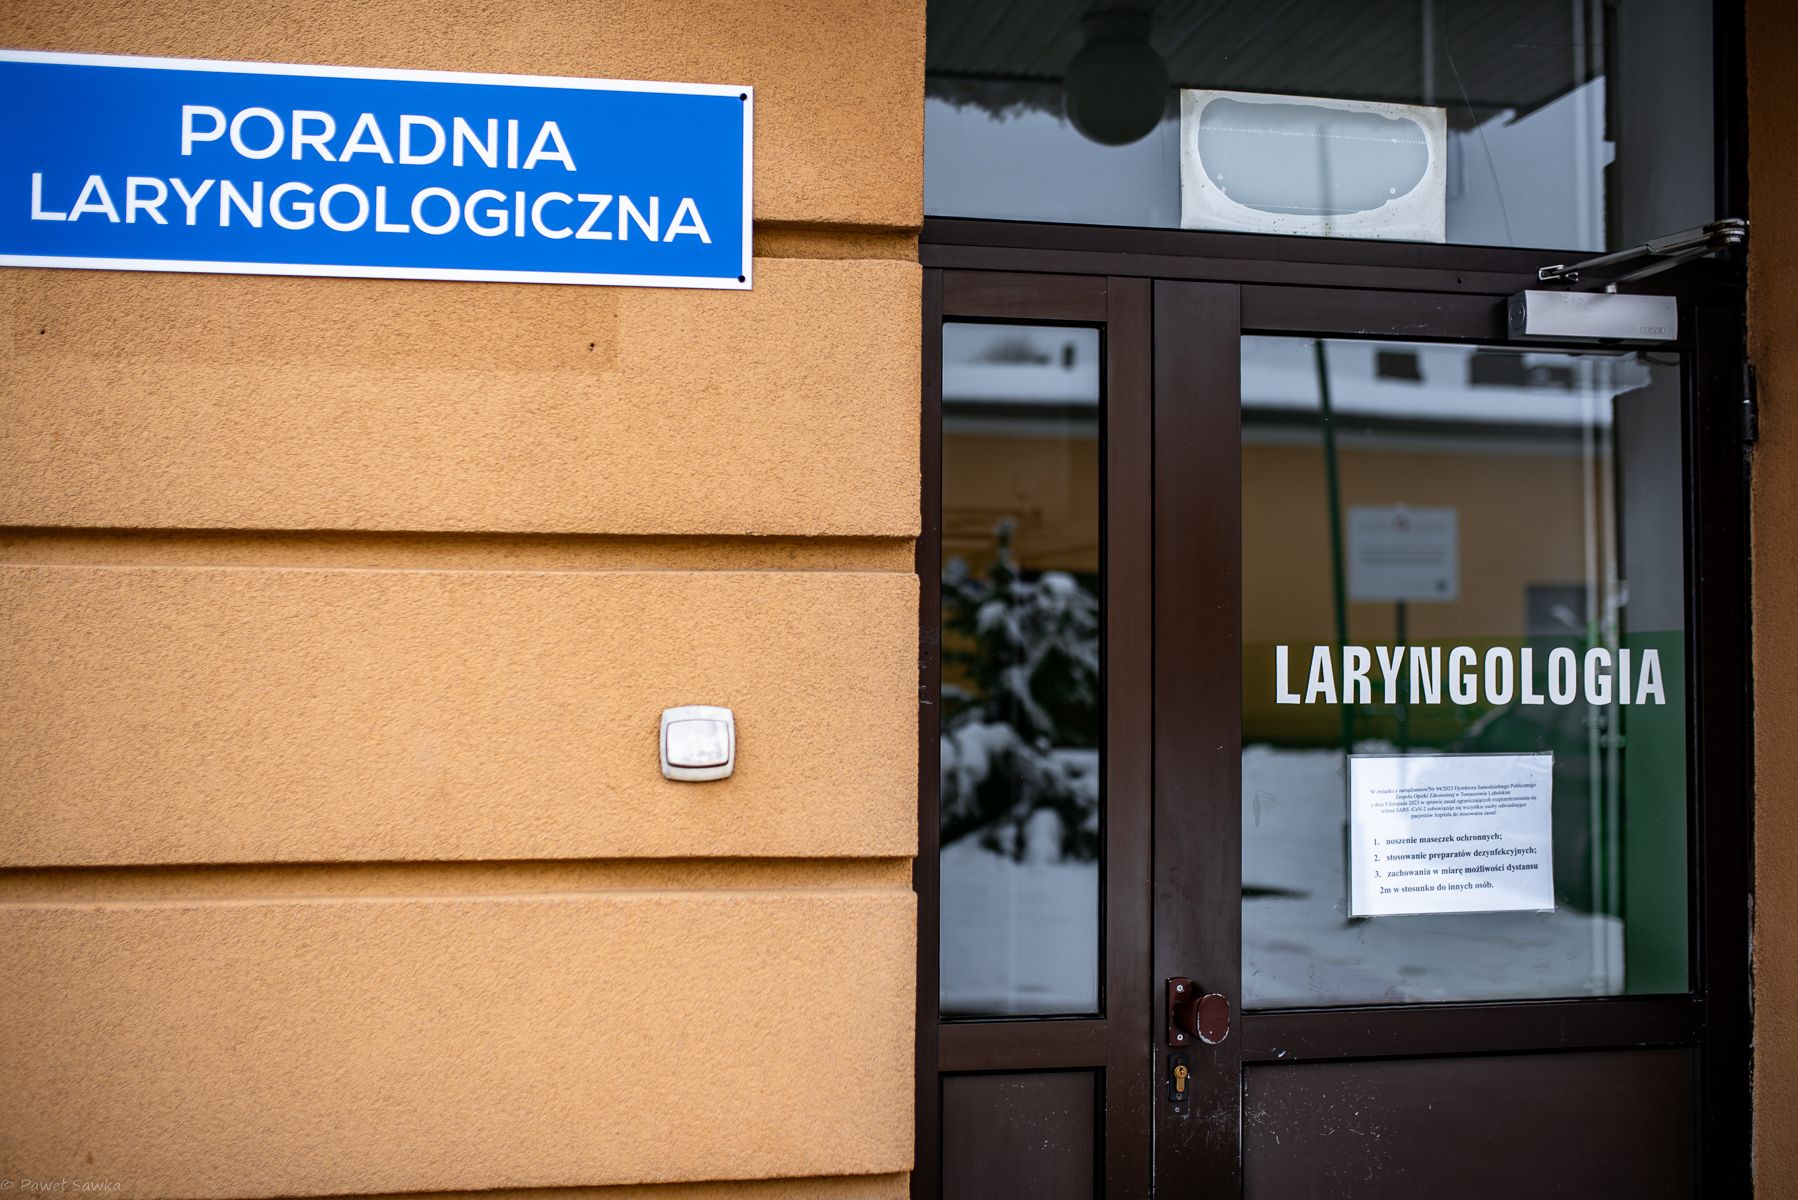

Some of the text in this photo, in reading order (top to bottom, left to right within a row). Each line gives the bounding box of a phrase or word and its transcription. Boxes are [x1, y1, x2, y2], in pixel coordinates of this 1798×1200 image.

[181, 104, 577, 172] PORADNIA
[31, 172, 713, 244] LARYNGOLOGICZNA
[1276, 645, 1666, 706] LARYNGOLOGIA
[1373, 832, 1502, 846] 1. noszenie maseczek ochronnych;
[1373, 846, 1537, 862] 2. stosowanie preparatów dezynfekcyjnych;
[1374, 870, 1382, 878] 3.
[1387, 867, 1431, 878] zachowania
[1441, 866, 1463, 876] miarę
[1464, 864, 1505, 874] możliwości
[1506, 863, 1539, 873] dystansu
[1379, 886, 1392, 894] 2m
[1401, 884, 1435, 893] stosunku
[1436, 883, 1447, 891] do
[1448, 882, 1473, 892] innych
[1474, 880, 1495, 889] osób.
